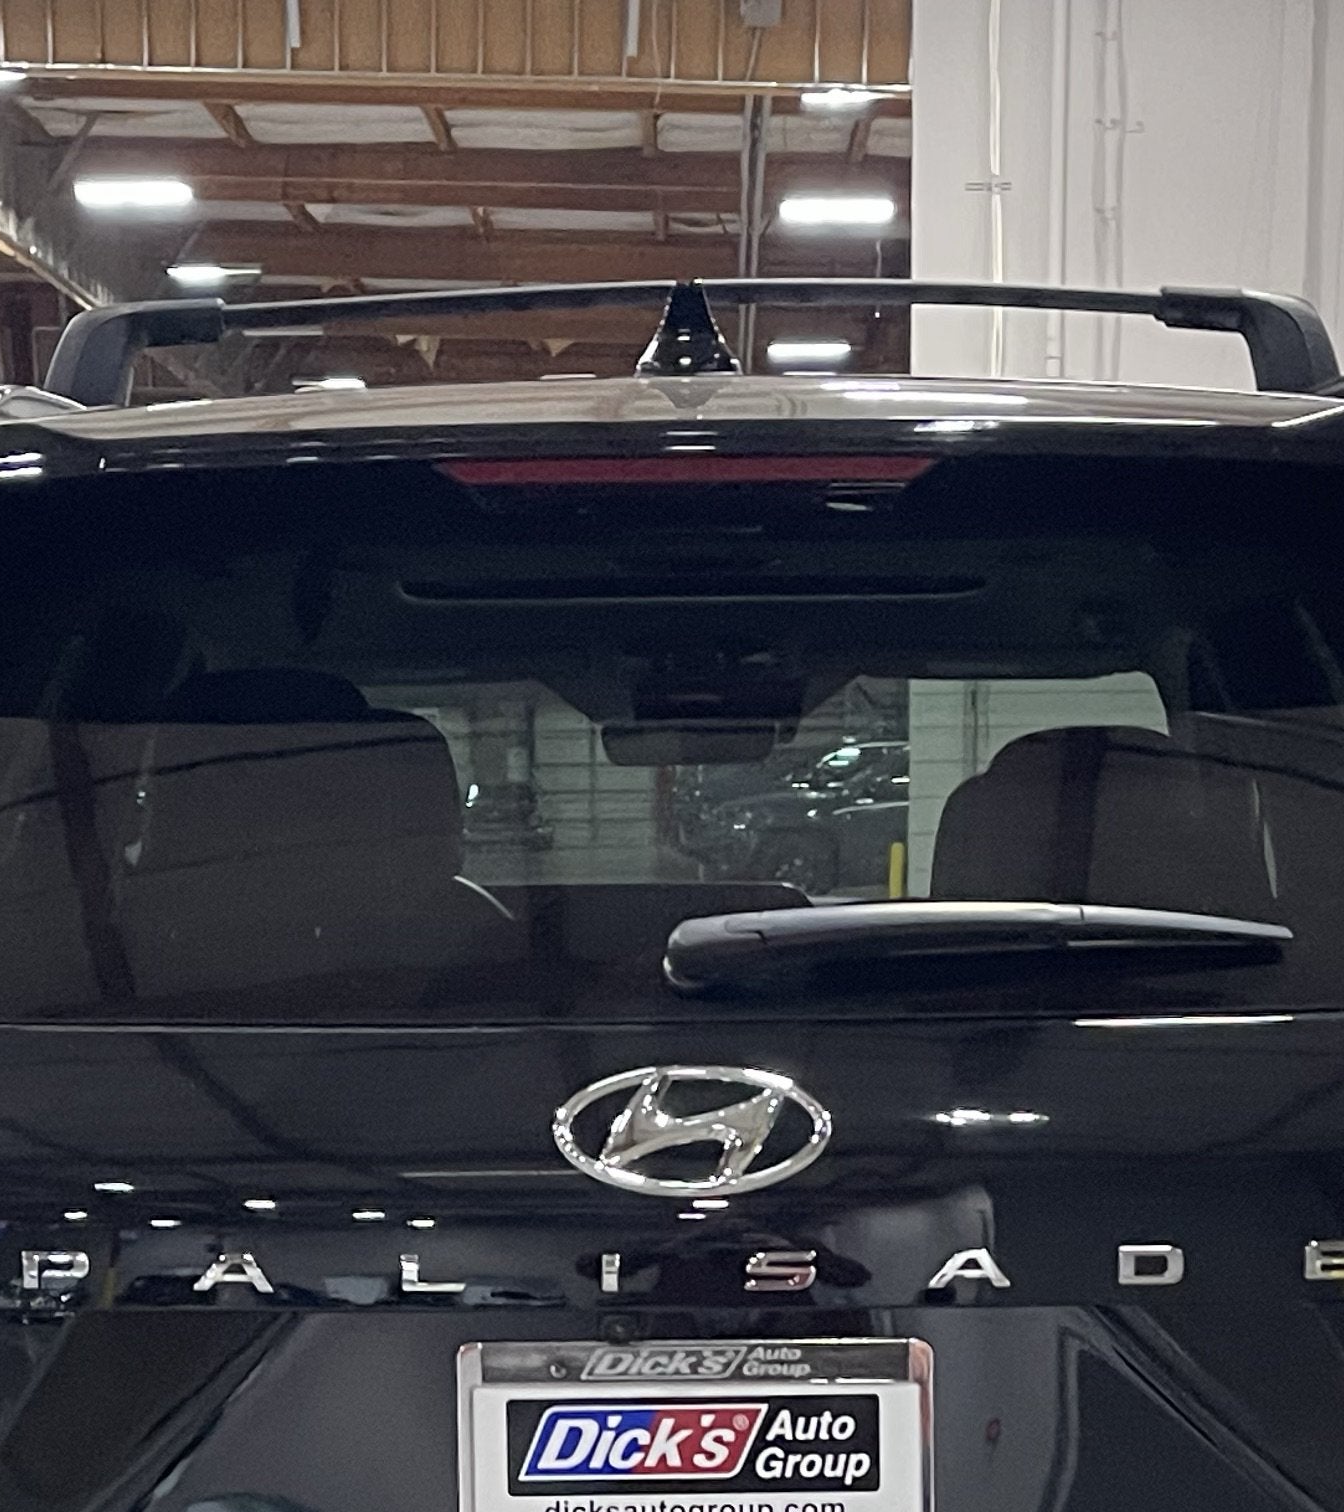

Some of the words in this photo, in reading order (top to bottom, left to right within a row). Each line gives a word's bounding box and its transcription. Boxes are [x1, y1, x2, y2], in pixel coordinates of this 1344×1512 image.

[592, 1348, 729, 1376] Dick's
[742, 1360, 812, 1378] Group
[747, 1346, 802, 1361] Auto
[765, 1408, 857, 1442] Auto
[535, 1412, 736, 1471] Dick's
[755, 1447, 872, 1487] Group
